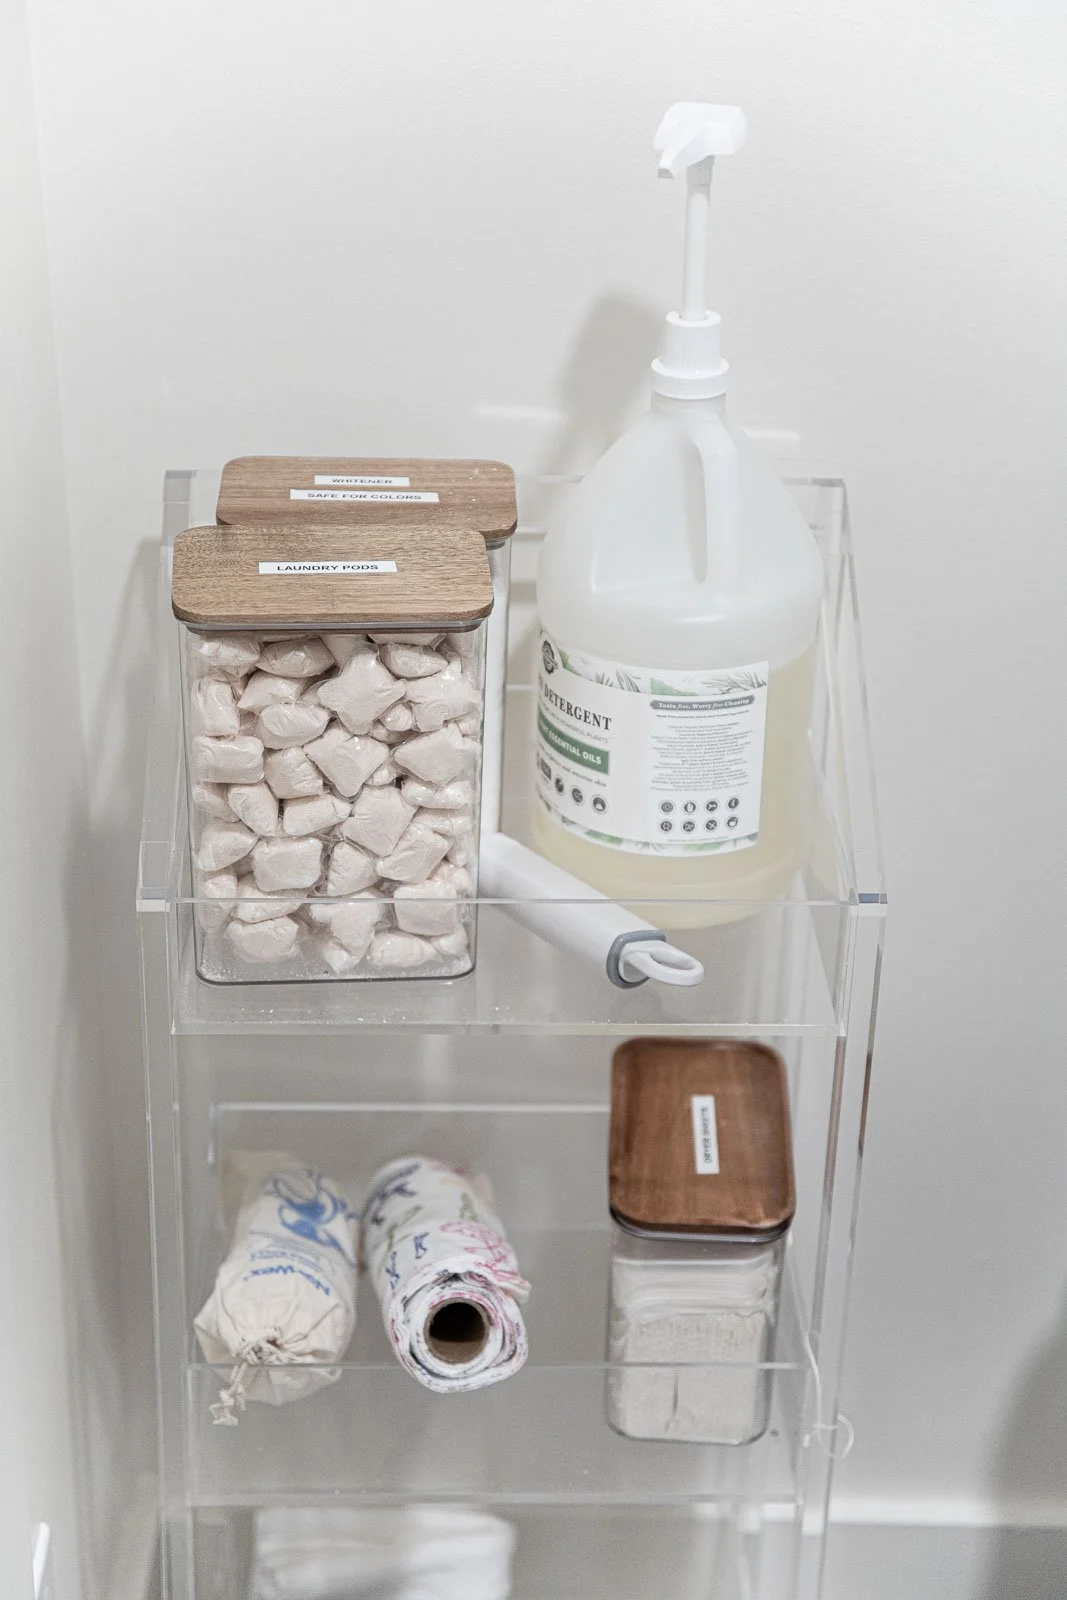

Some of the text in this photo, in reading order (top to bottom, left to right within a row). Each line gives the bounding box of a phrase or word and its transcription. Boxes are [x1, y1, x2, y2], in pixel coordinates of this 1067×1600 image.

[544, 684, 612, 730] DETERGENT
[548, 731, 581, 757] ESSENTIAL
[582, 751, 602, 765] OILS
